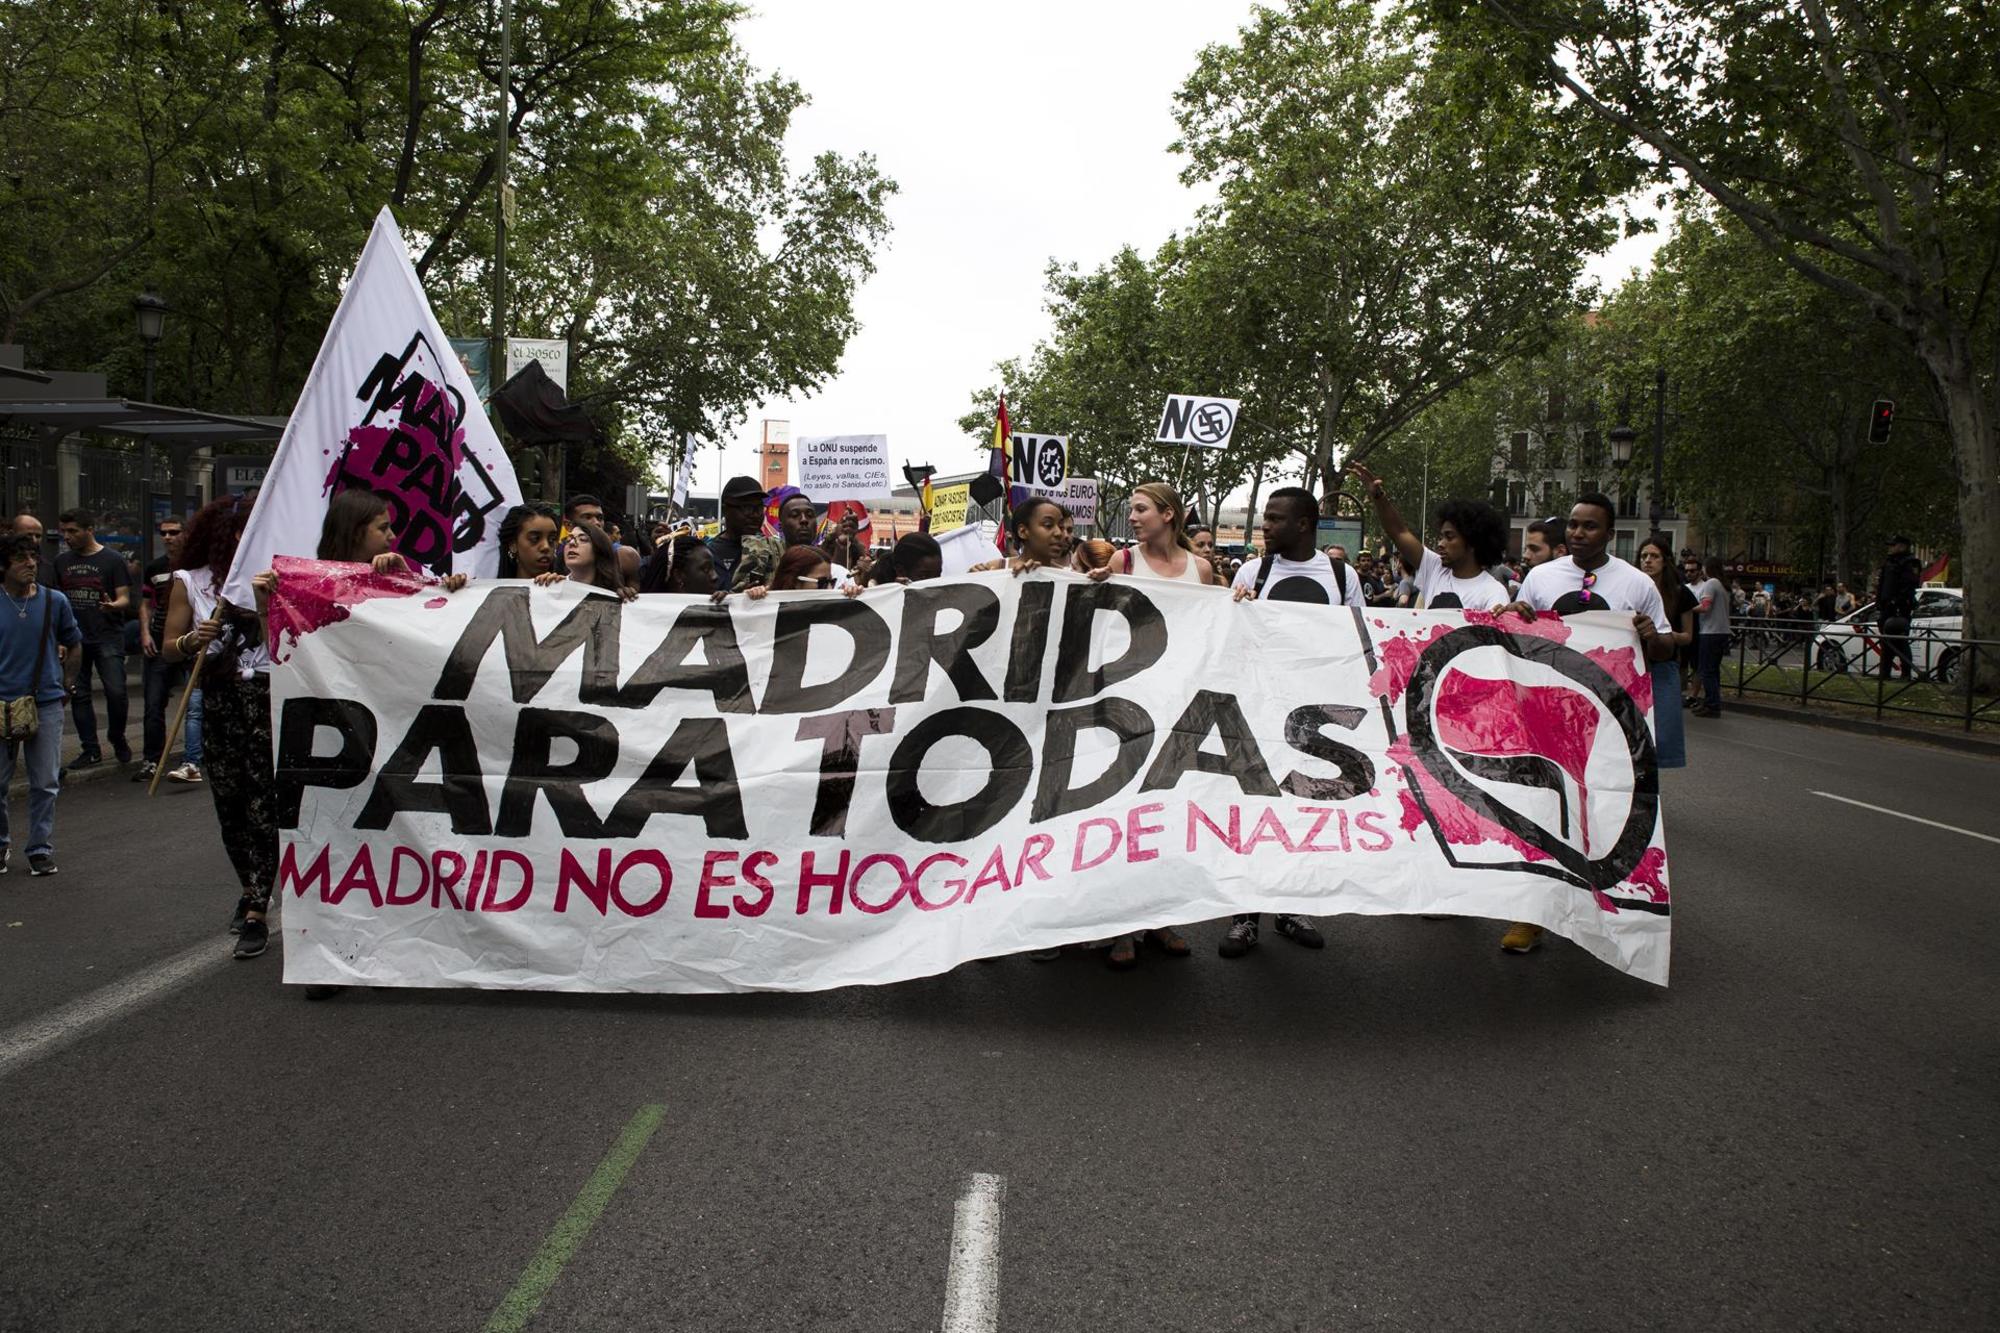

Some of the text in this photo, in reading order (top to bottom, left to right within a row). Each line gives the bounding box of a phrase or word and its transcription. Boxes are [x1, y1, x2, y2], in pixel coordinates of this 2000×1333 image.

[808, 443, 878, 454] La ONU suspende
[809, 456, 838, 467] España
[839, 457, 850, 465] en
[851, 456, 885, 466] racismo.
[1070, 485, 1096, 499] EURO-
[432, 580, 1168, 715] MADRID
[275, 689, 1376, 844] PARA TODAS
[280, 800, 1394, 919] MADRID NO ES HOGAR DE NAZIS
